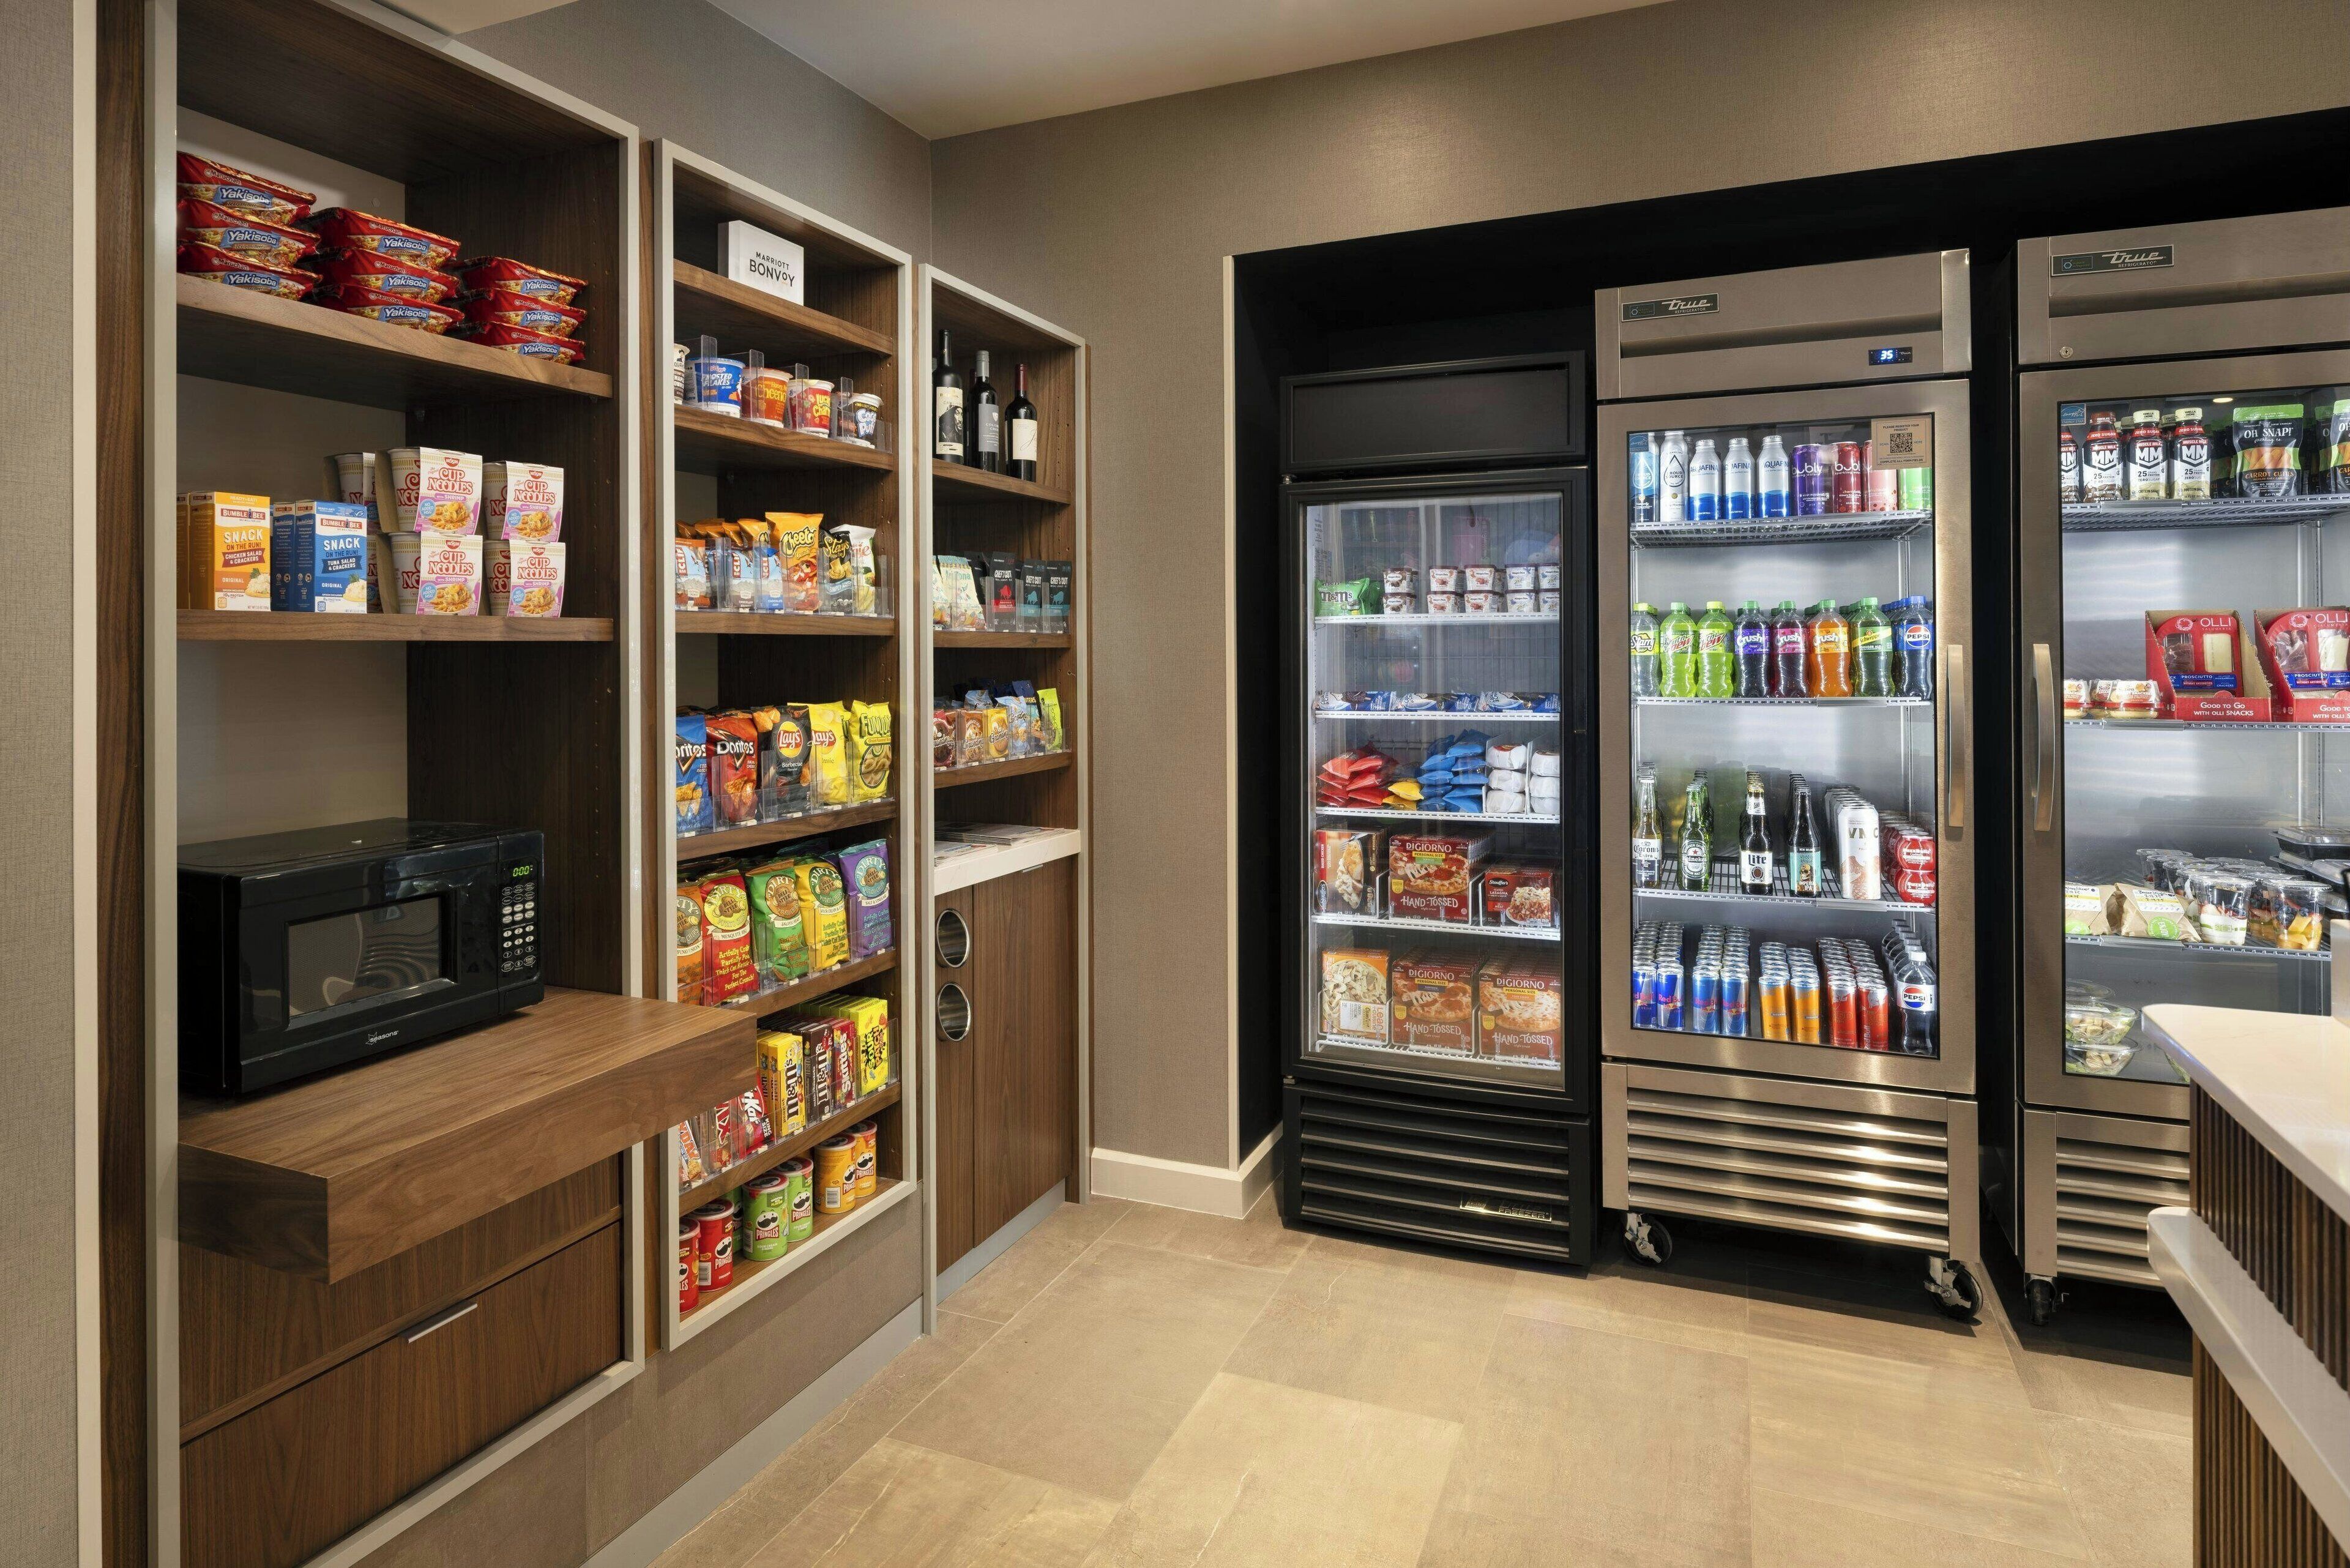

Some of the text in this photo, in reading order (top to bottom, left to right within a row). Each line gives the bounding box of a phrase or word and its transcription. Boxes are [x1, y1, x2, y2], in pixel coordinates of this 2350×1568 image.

[212, 170, 242, 185] Maruchan
[220, 187, 271, 204] Yakisoba
[376, 223, 402, 235] Maruchan
[228, 230, 277, 244] Yakisoba
[384, 237, 427, 252] Yakisoba
[219, 258, 249, 271] Maruchan
[756, 252, 789, 270] MARRIOTT
[381, 263, 406, 274] Maruchan
[750, 259, 794, 286] BONVOY
[227, 274, 277, 286] Yakisoba
[387, 276, 427, 289] Yakisoba
[525, 280, 558, 291] Yakisoba
[376, 294, 403, 305] Maruchan
[384, 308, 427, 319] Yakisoba
[526, 312, 559, 323] Yakisoba
[523, 345, 558, 355] Yakisoba
[1881, 350, 1893, 360] 35
[2244, 428, 2291, 438] OH SNAP!
[439, 468, 465, 480] CUP
[428, 478, 473, 495] NOODLES
[524, 480, 548, 492] CUP
[514, 490, 555, 504] NOODLES
[223, 509, 247, 518] BUMBLE
[224, 529, 263, 544] SNACK
[323, 538, 360, 551] SNACK
[440, 551, 465, 564] CUP
[527, 558, 550, 569] CUP
[428, 561, 474, 576] NOODLES
[517, 567, 557, 580] NOODLES
[2200, 618, 2231, 627] OLLI
[2315, 613, 2348, 622] OLLI
[779, 730, 801, 749] Lay's
[812, 730, 834, 747] Lay's
[717, 740, 754, 755] Doritos
[1406, 843, 1452, 853] DIGIORNO
[1748, 854, 1767, 865] Lite
[513, 866, 529, 876] 0:00
[1400, 895, 1458, 908] HAND-TOSSED
[1409, 969, 1455, 980] DIGIORNO
[1497, 978, 1545, 990] DIGIORNO
[1403, 1022, 1461, 1035] HAND-TOSSED
[370, 1031, 398, 1042] seasons
[1492, 1032, 1553, 1045] HAND-TOSSED
[873, 1026, 882, 1068] PATCH
[840, 1034, 851, 1093] Skittles
[857, 1168, 873, 1179] PRINGLES
[793, 1208, 810, 1221] PRINGLES
[1499, 1208, 1545, 1219] FREEZER
[756, 1226, 778, 1240] PRINGLES
